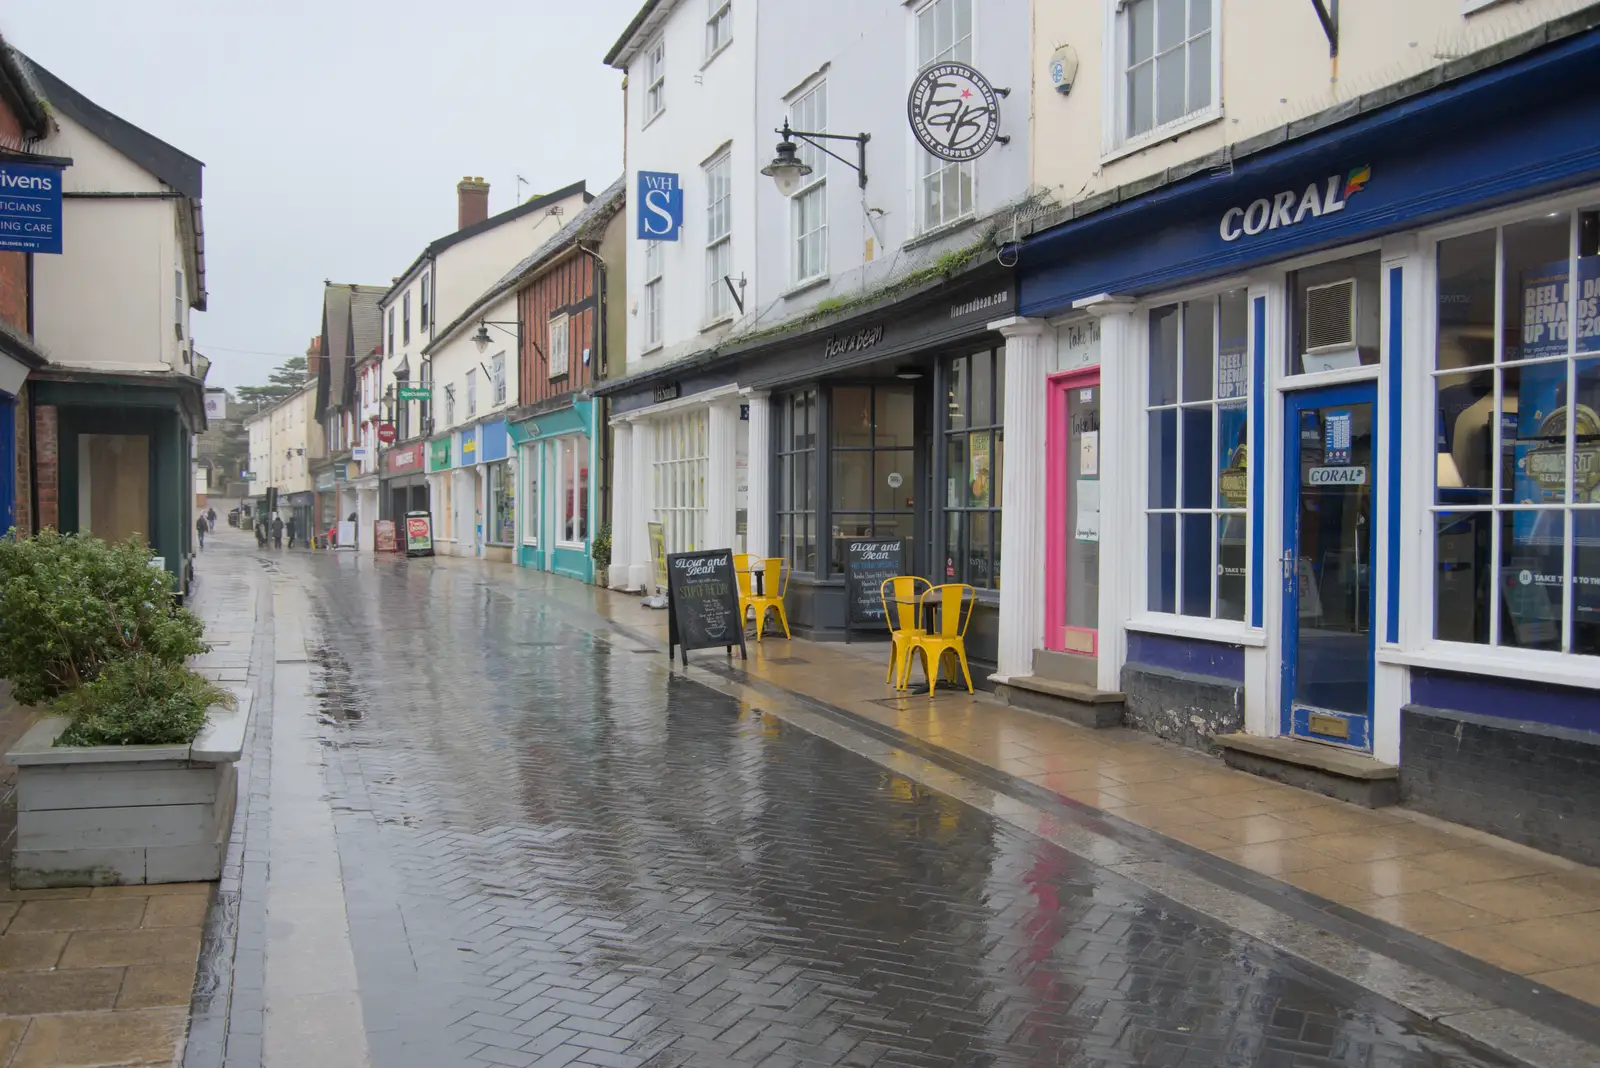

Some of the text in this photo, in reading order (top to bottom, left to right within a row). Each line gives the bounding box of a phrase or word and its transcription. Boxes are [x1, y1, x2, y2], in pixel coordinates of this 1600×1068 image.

[915, 67, 995, 111] HAND CRAFTED BAKING
[936, 144, 972, 157] COFFEE
[972, 122, 997, 154] MAKING
[645, 175, 672, 190] WH
[644, 189, 673, 235] S
[1219, 174, 1346, 242] CORAL
[24, 223, 52, 233] CARE
[1525, 284, 1559, 307] REEL
[1525, 297, 1598, 326] REWADS
[856, 325, 885, 350] Bean
[1068, 325, 1087, 350] Take
[1524, 324, 1544, 344] UP
[1548, 321, 1570, 341] TO
[1311, 469, 1356, 482] CORAL
[881, 541, 901, 551] and
[707, 555, 728, 566] and
